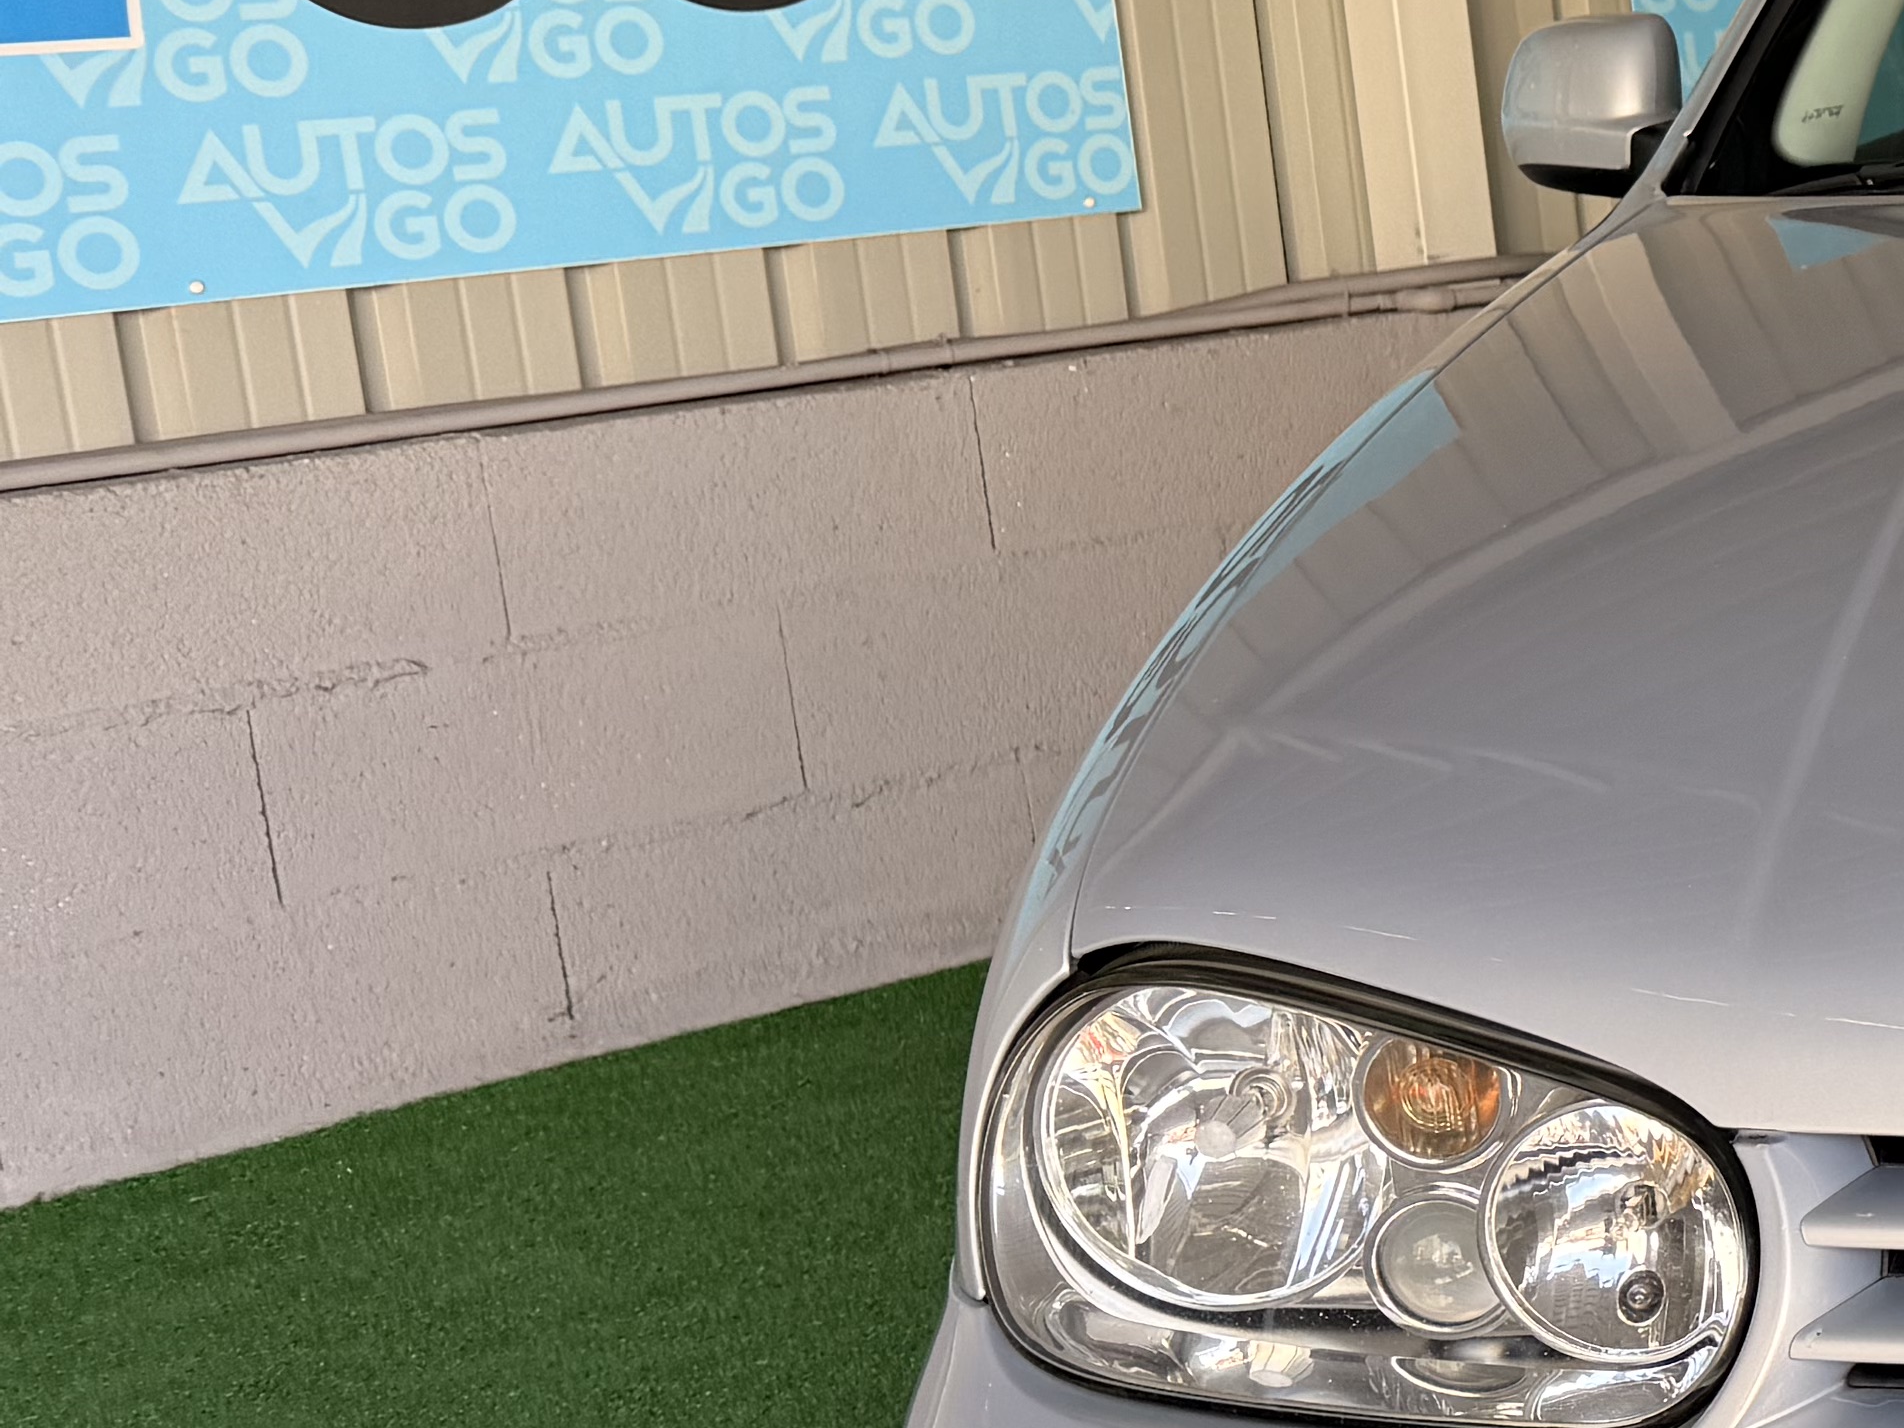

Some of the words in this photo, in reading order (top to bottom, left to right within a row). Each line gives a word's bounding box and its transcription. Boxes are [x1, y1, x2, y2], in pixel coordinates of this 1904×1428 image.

[547, 85, 833, 172] AUTOS
[871, 65, 1124, 146] AUTOS
[176, 107, 503, 202] AUTOS
[614, 157, 843, 234] VIGO
[930, 133, 1132, 205] VIGO
[253, 184, 514, 268] VIGO
